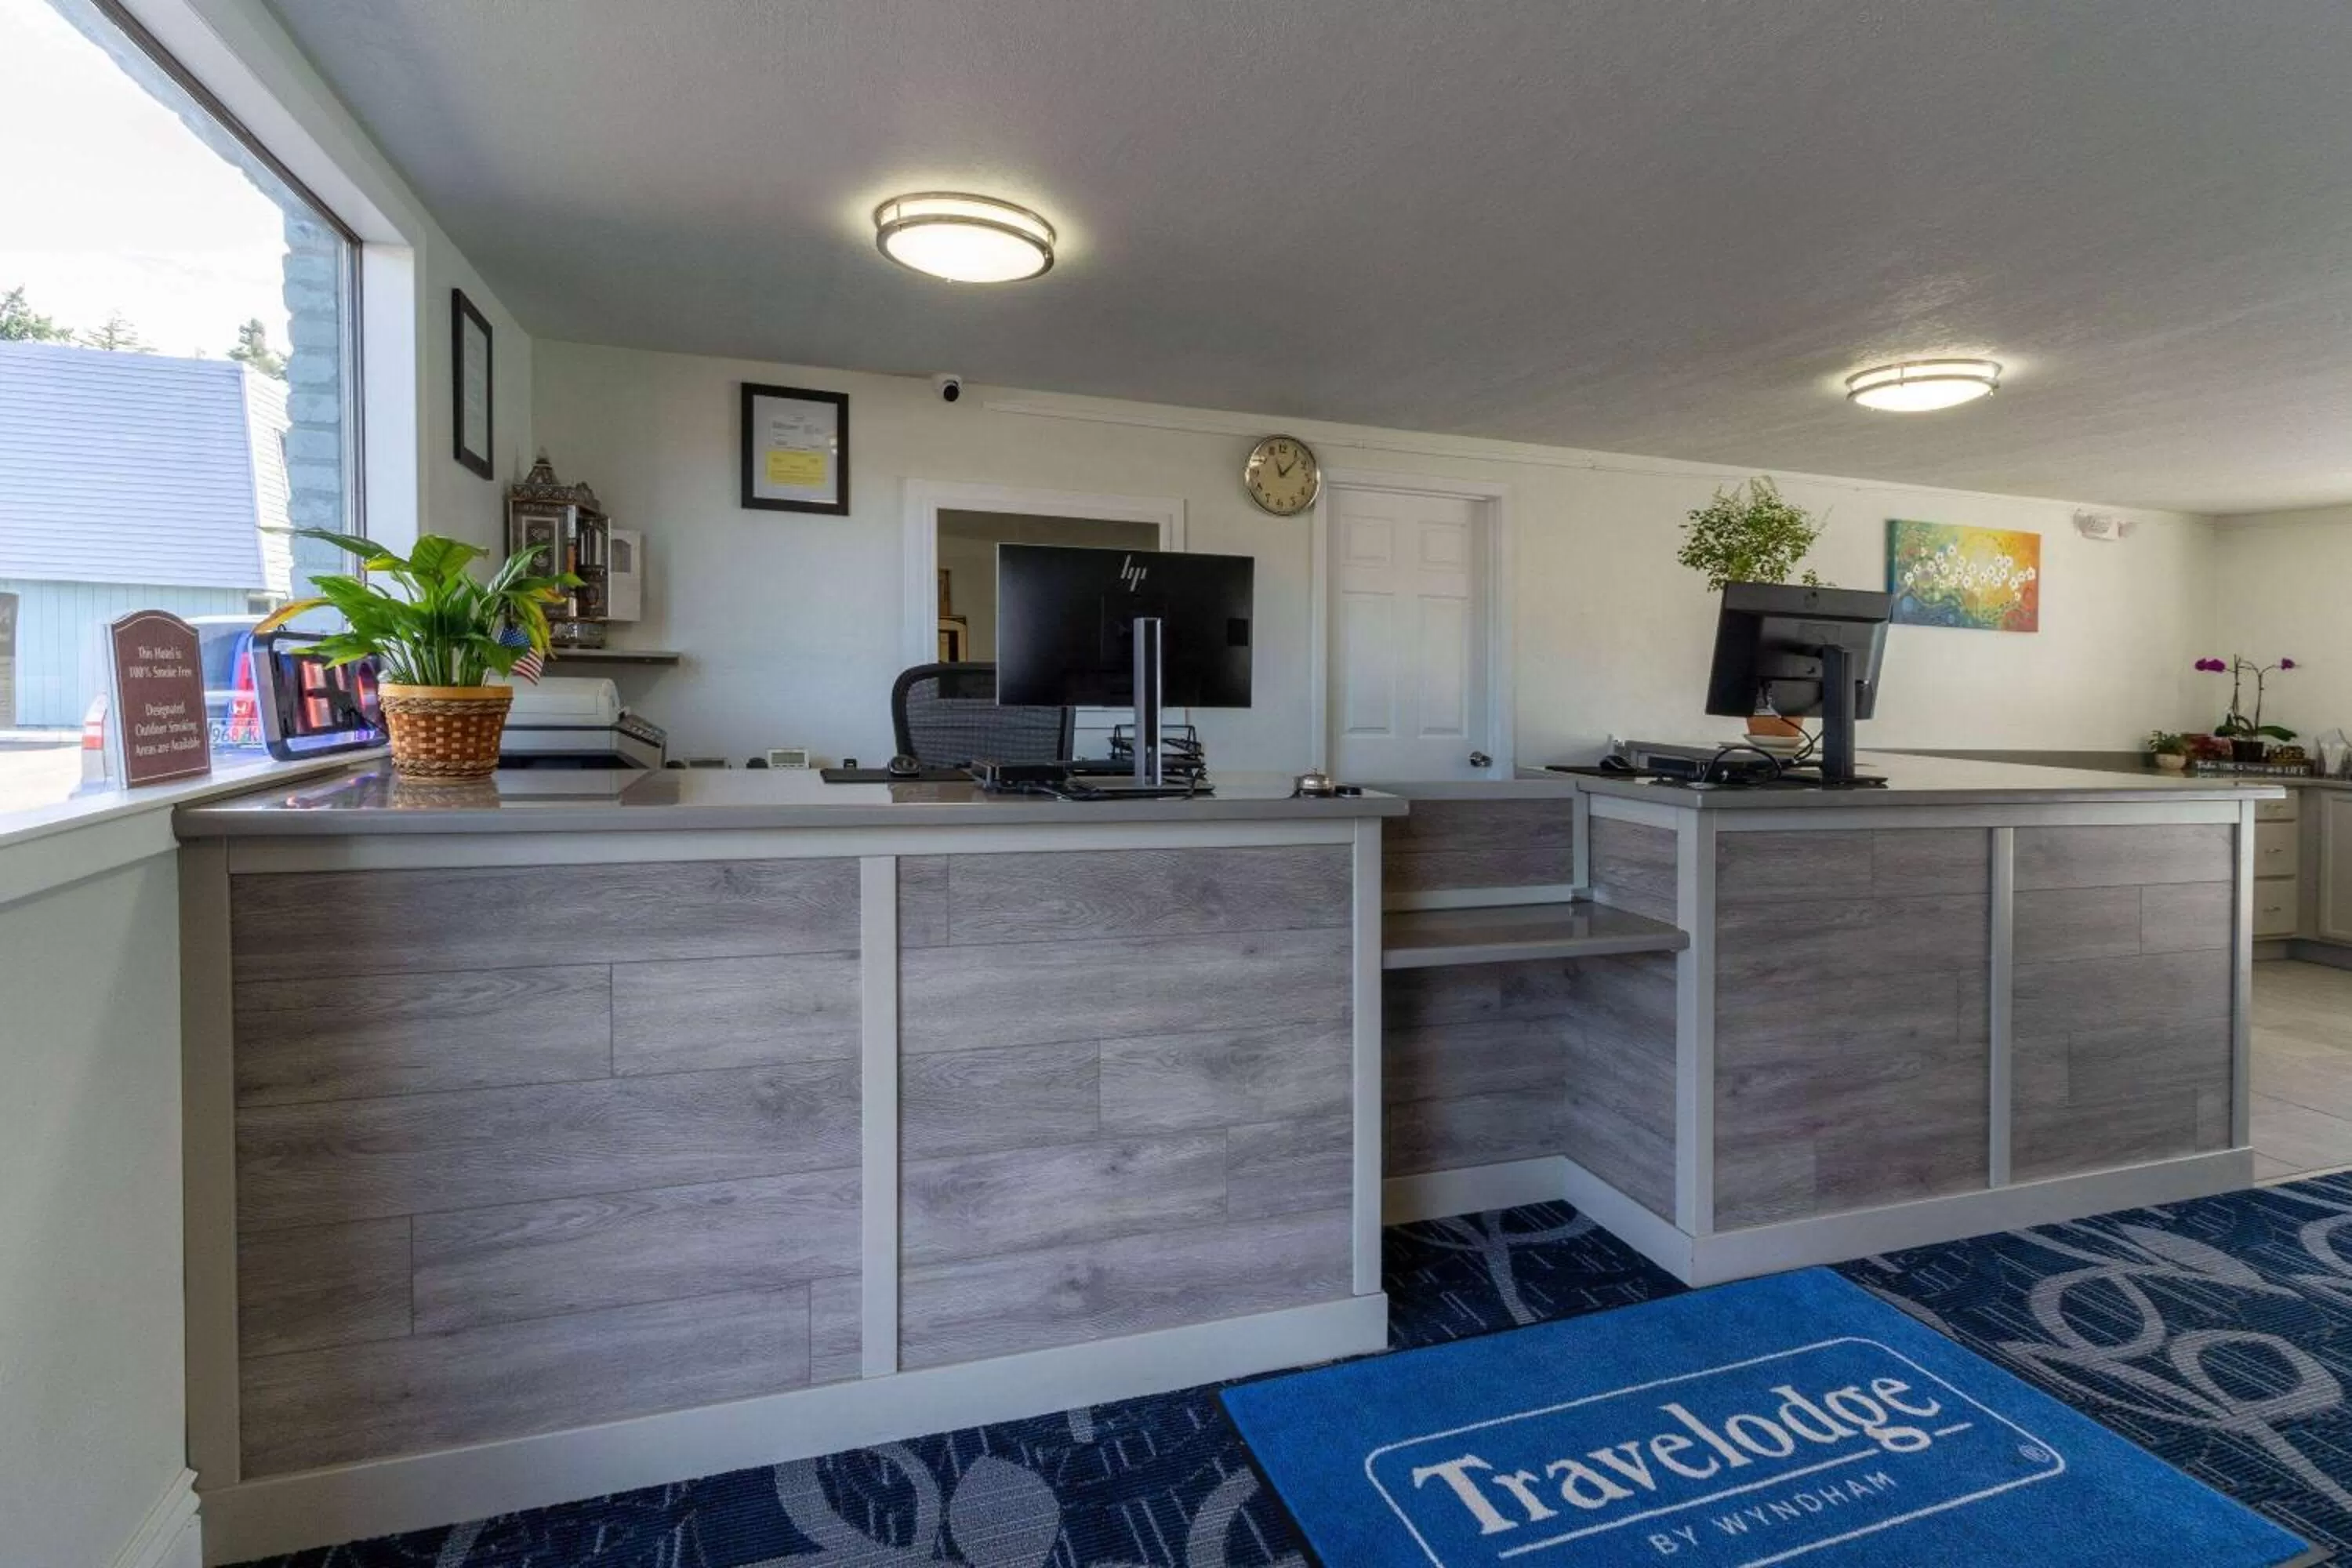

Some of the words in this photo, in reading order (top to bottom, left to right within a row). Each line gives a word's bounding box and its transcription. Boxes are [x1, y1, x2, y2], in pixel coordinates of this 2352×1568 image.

[1120, 554, 1147, 592] hp
[1412, 1377, 1941, 1535] Travelodge
[1648, 1525, 1699, 1555] BY
[1711, 1470, 1900, 1535] WYNDHAM
